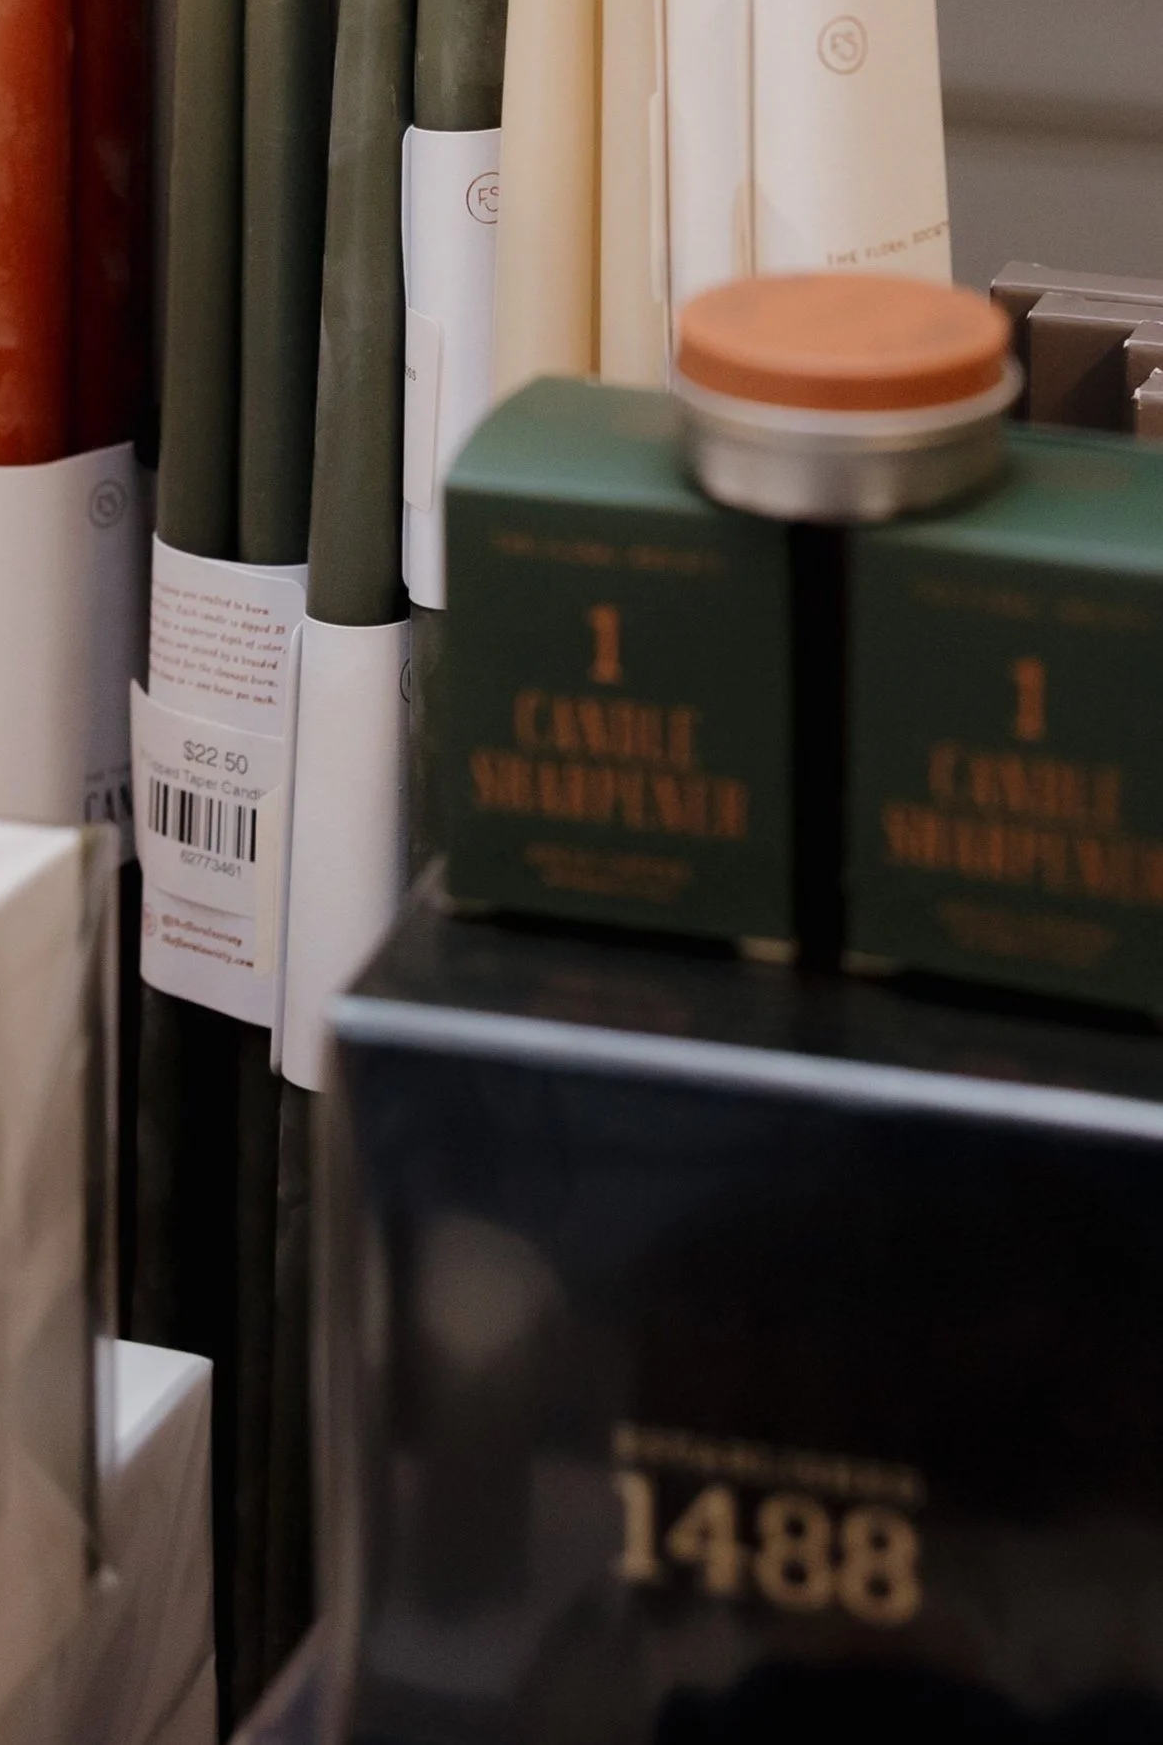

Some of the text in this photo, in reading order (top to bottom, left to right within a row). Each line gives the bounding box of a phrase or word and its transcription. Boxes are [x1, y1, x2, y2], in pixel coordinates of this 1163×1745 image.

[183, 739, 249, 775] $22.50
[183, 770, 218, 791] Taper
[612, 1469, 923, 1626] 1488
